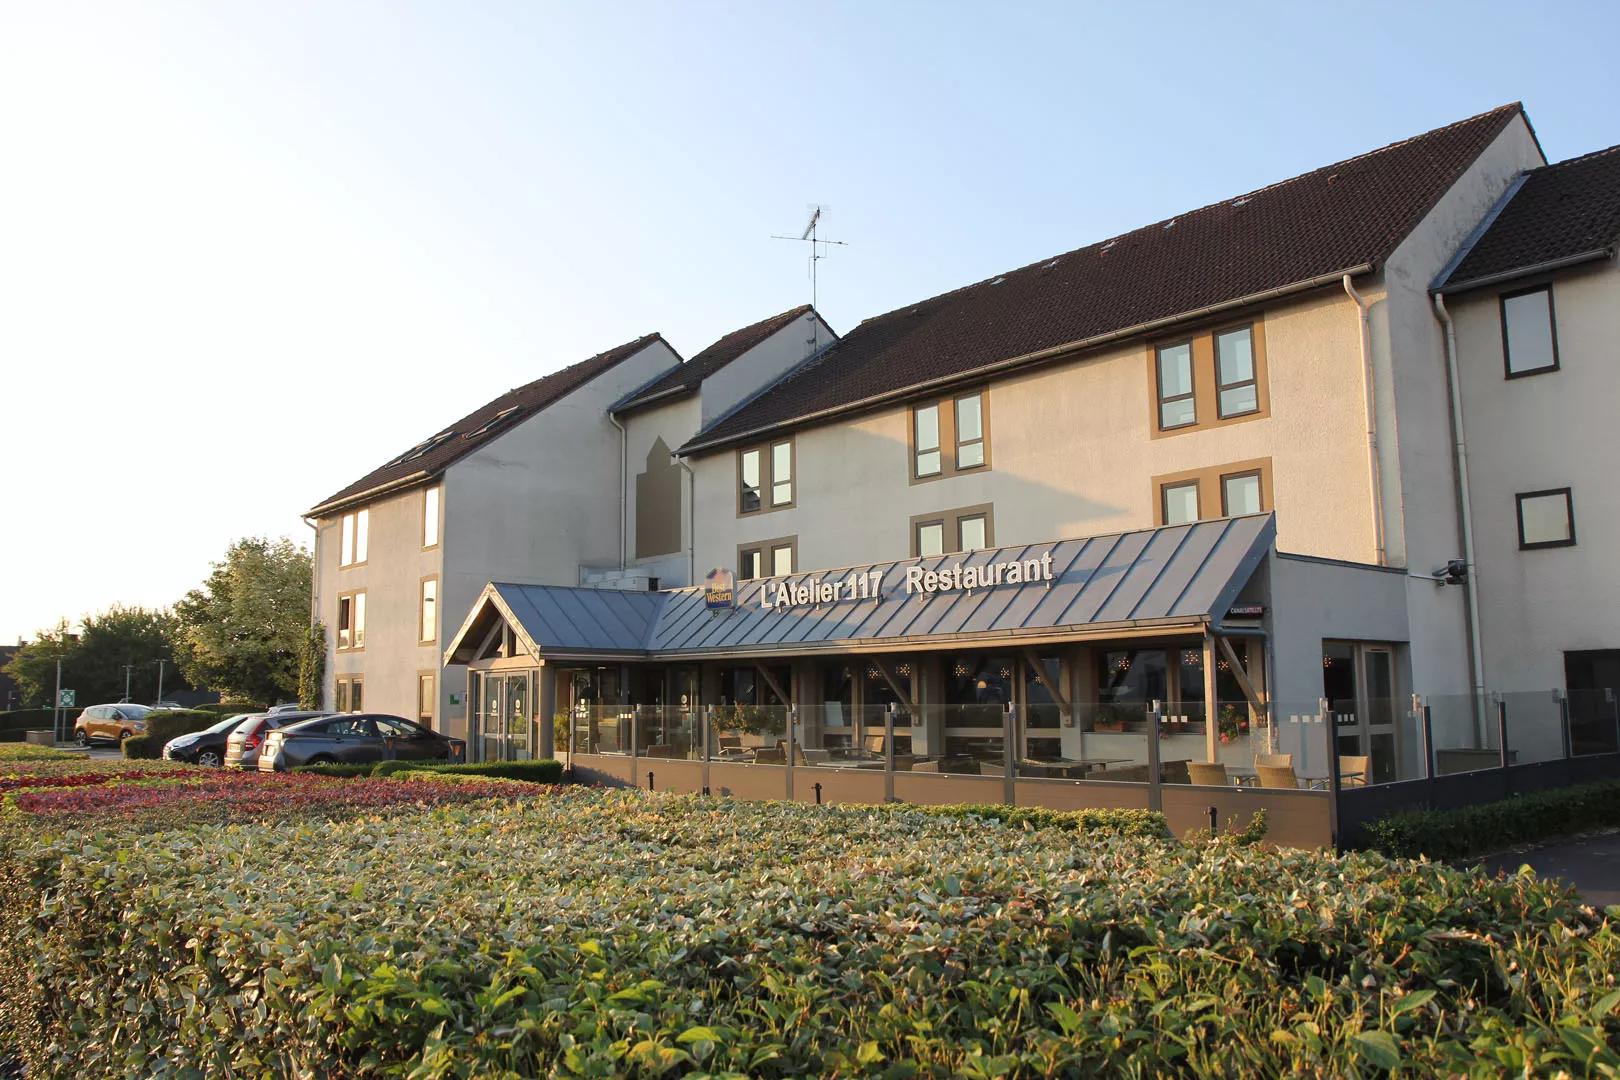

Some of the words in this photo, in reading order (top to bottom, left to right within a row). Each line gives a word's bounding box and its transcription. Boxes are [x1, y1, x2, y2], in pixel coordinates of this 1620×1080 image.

[761, 577, 844, 609] L'Atelier
[846, 571, 883, 600] 117
[906, 550, 1053, 594] Restaurant
[711, 583, 725, 593] Best
[706, 592, 732, 603] Western
